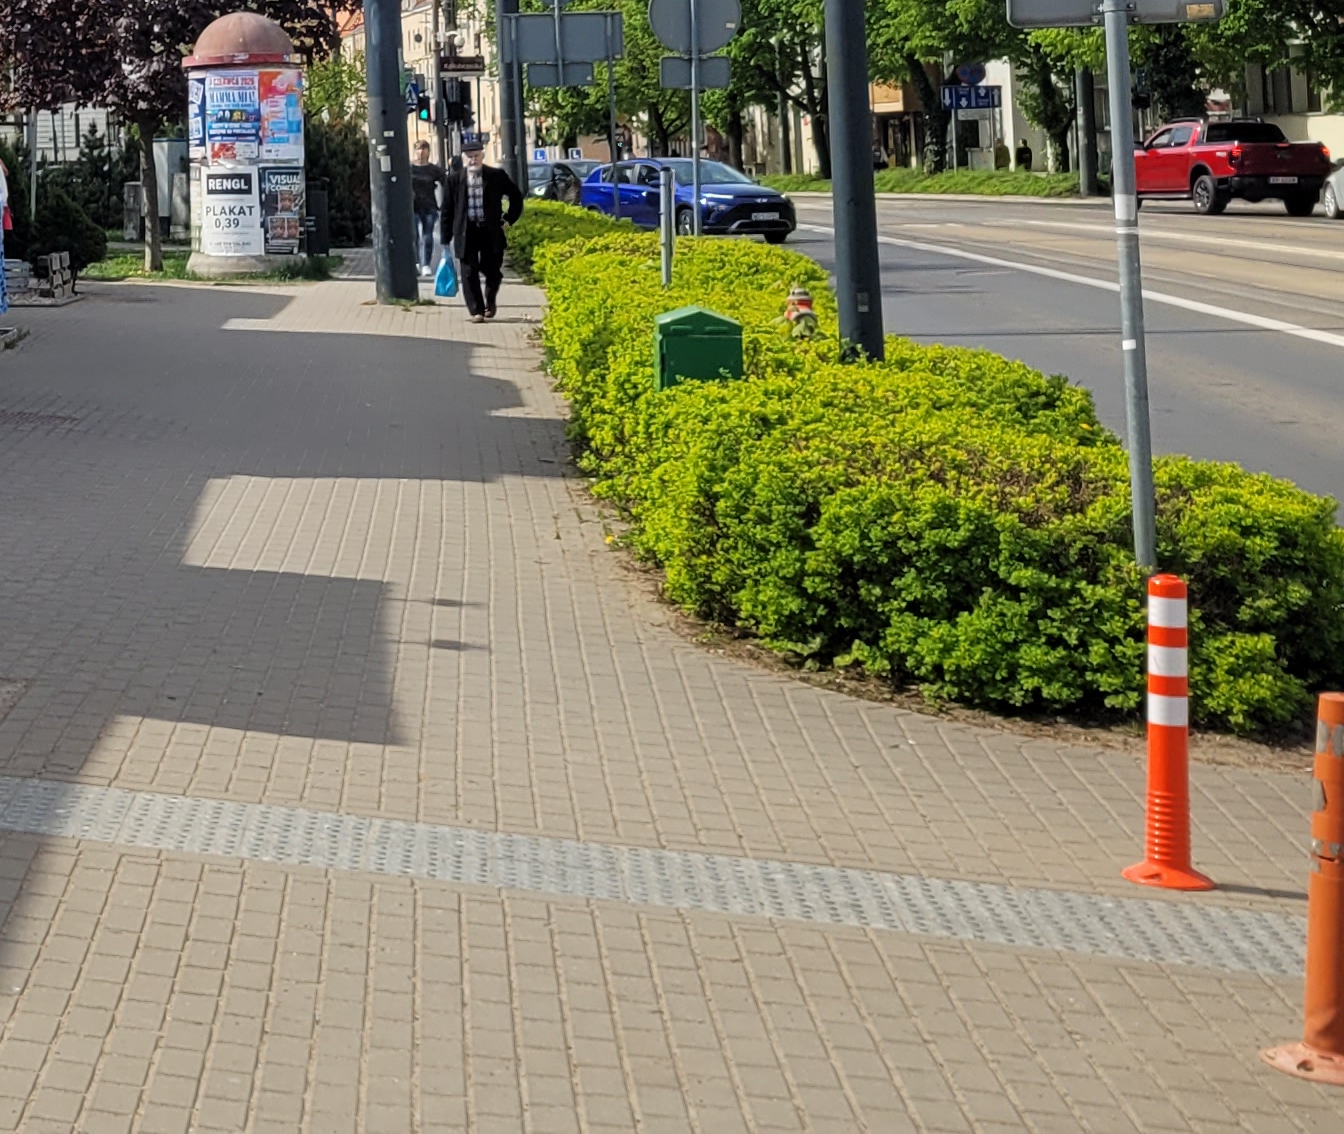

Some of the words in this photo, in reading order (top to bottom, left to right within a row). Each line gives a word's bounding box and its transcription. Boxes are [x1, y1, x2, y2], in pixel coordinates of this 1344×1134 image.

[537, 150, 543, 159] L
[572, 150, 580, 159] L
[208, 178, 249, 191] RENGL
[205, 205, 255, 217] PLAKAT
[214, 217, 240, 231] 0,39
